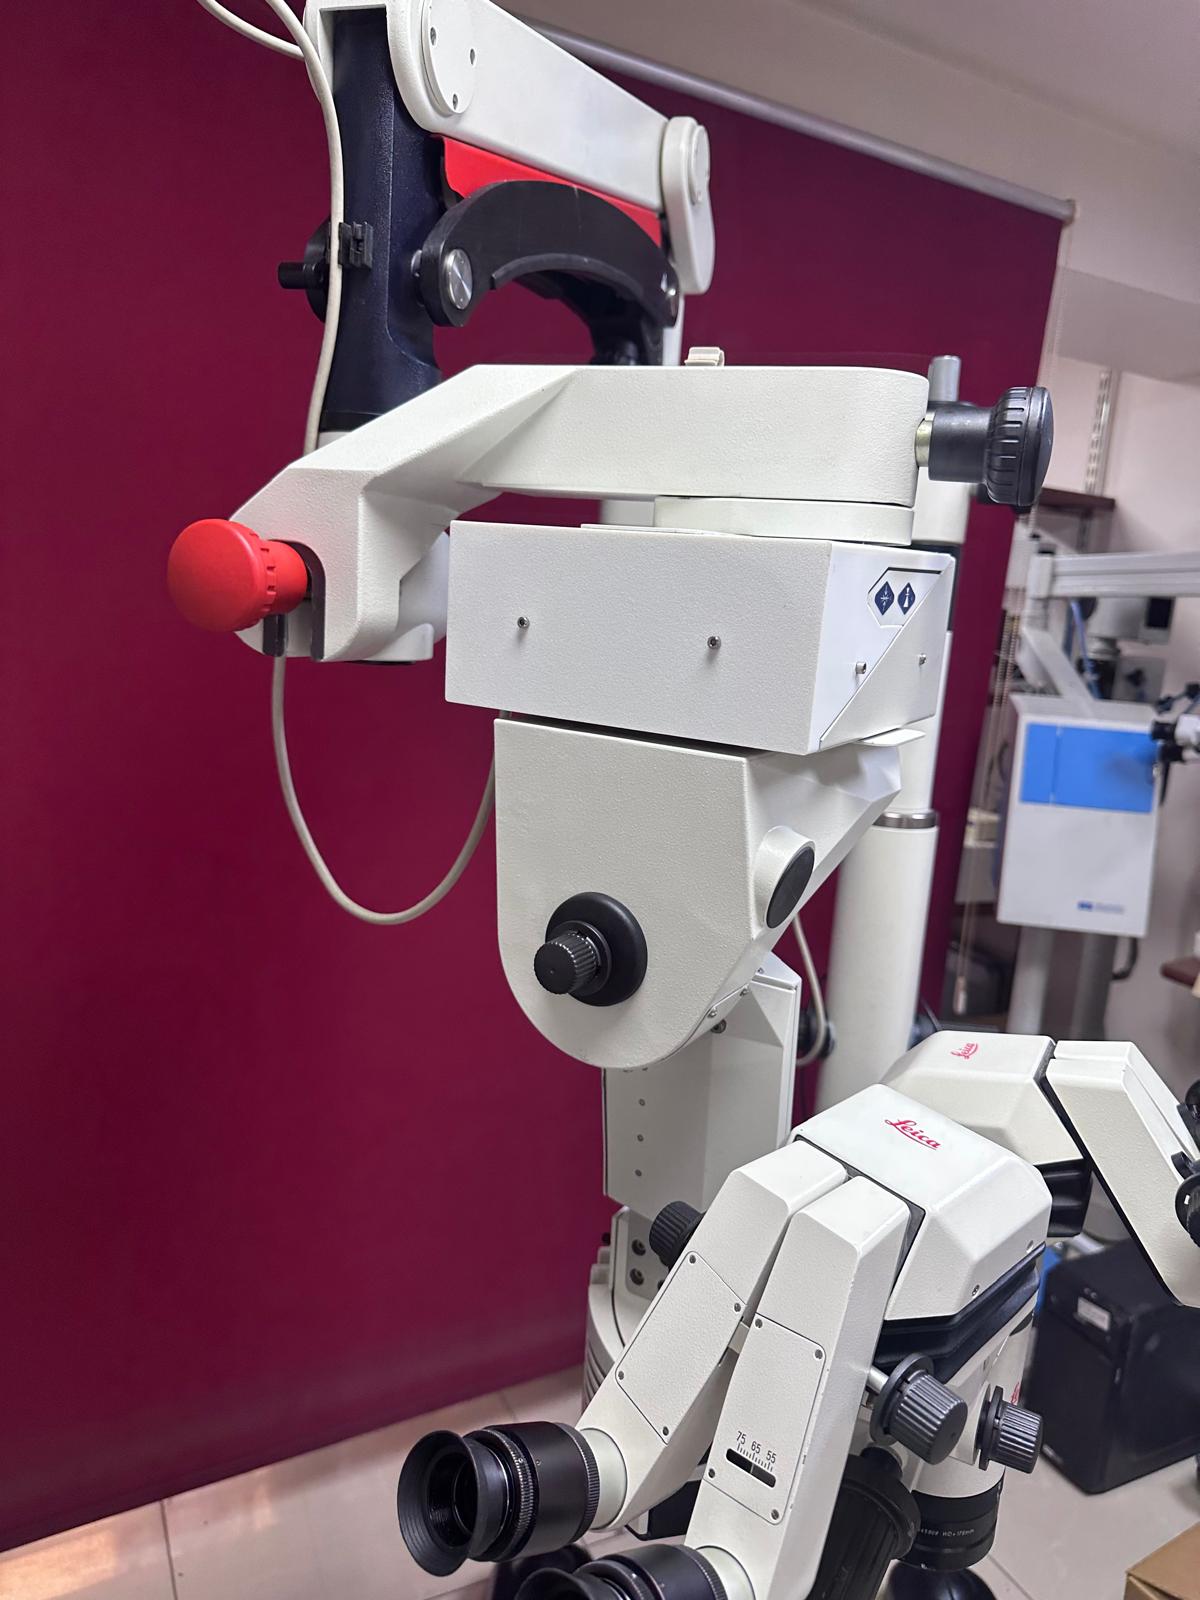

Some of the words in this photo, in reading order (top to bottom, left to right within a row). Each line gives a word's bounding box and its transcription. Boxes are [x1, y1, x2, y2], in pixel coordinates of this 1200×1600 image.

[884, 1119, 941, 1151] Leica
[736, 1430, 747, 1445] 75
[751, 1440, 761, 1454] 65
[766, 1450, 776, 1464] 55
